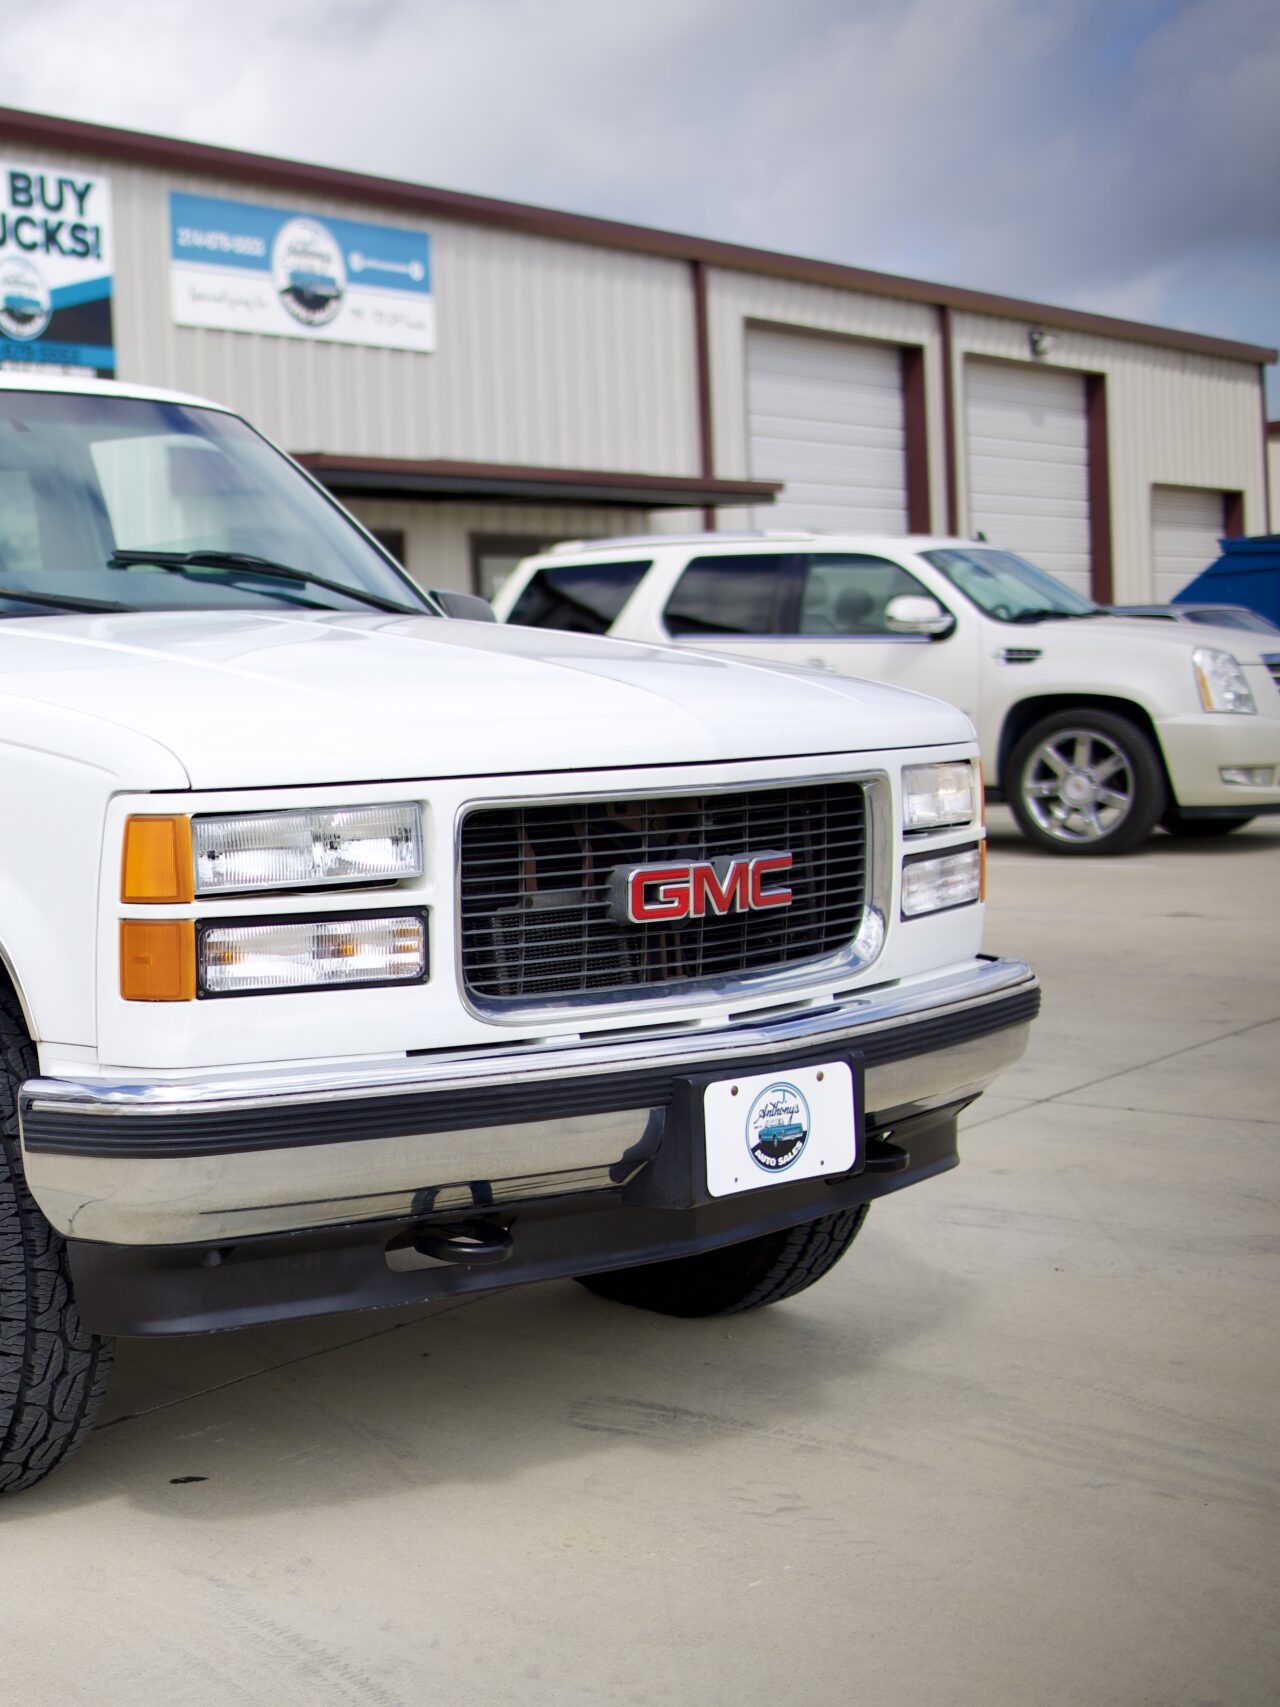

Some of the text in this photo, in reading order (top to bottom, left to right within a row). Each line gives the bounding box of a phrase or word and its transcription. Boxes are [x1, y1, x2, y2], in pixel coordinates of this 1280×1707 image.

[8, 170, 93, 216] BUY
[627, 852, 793, 924] GMC
[754, 1141, 803, 1167] AUTO SALES
